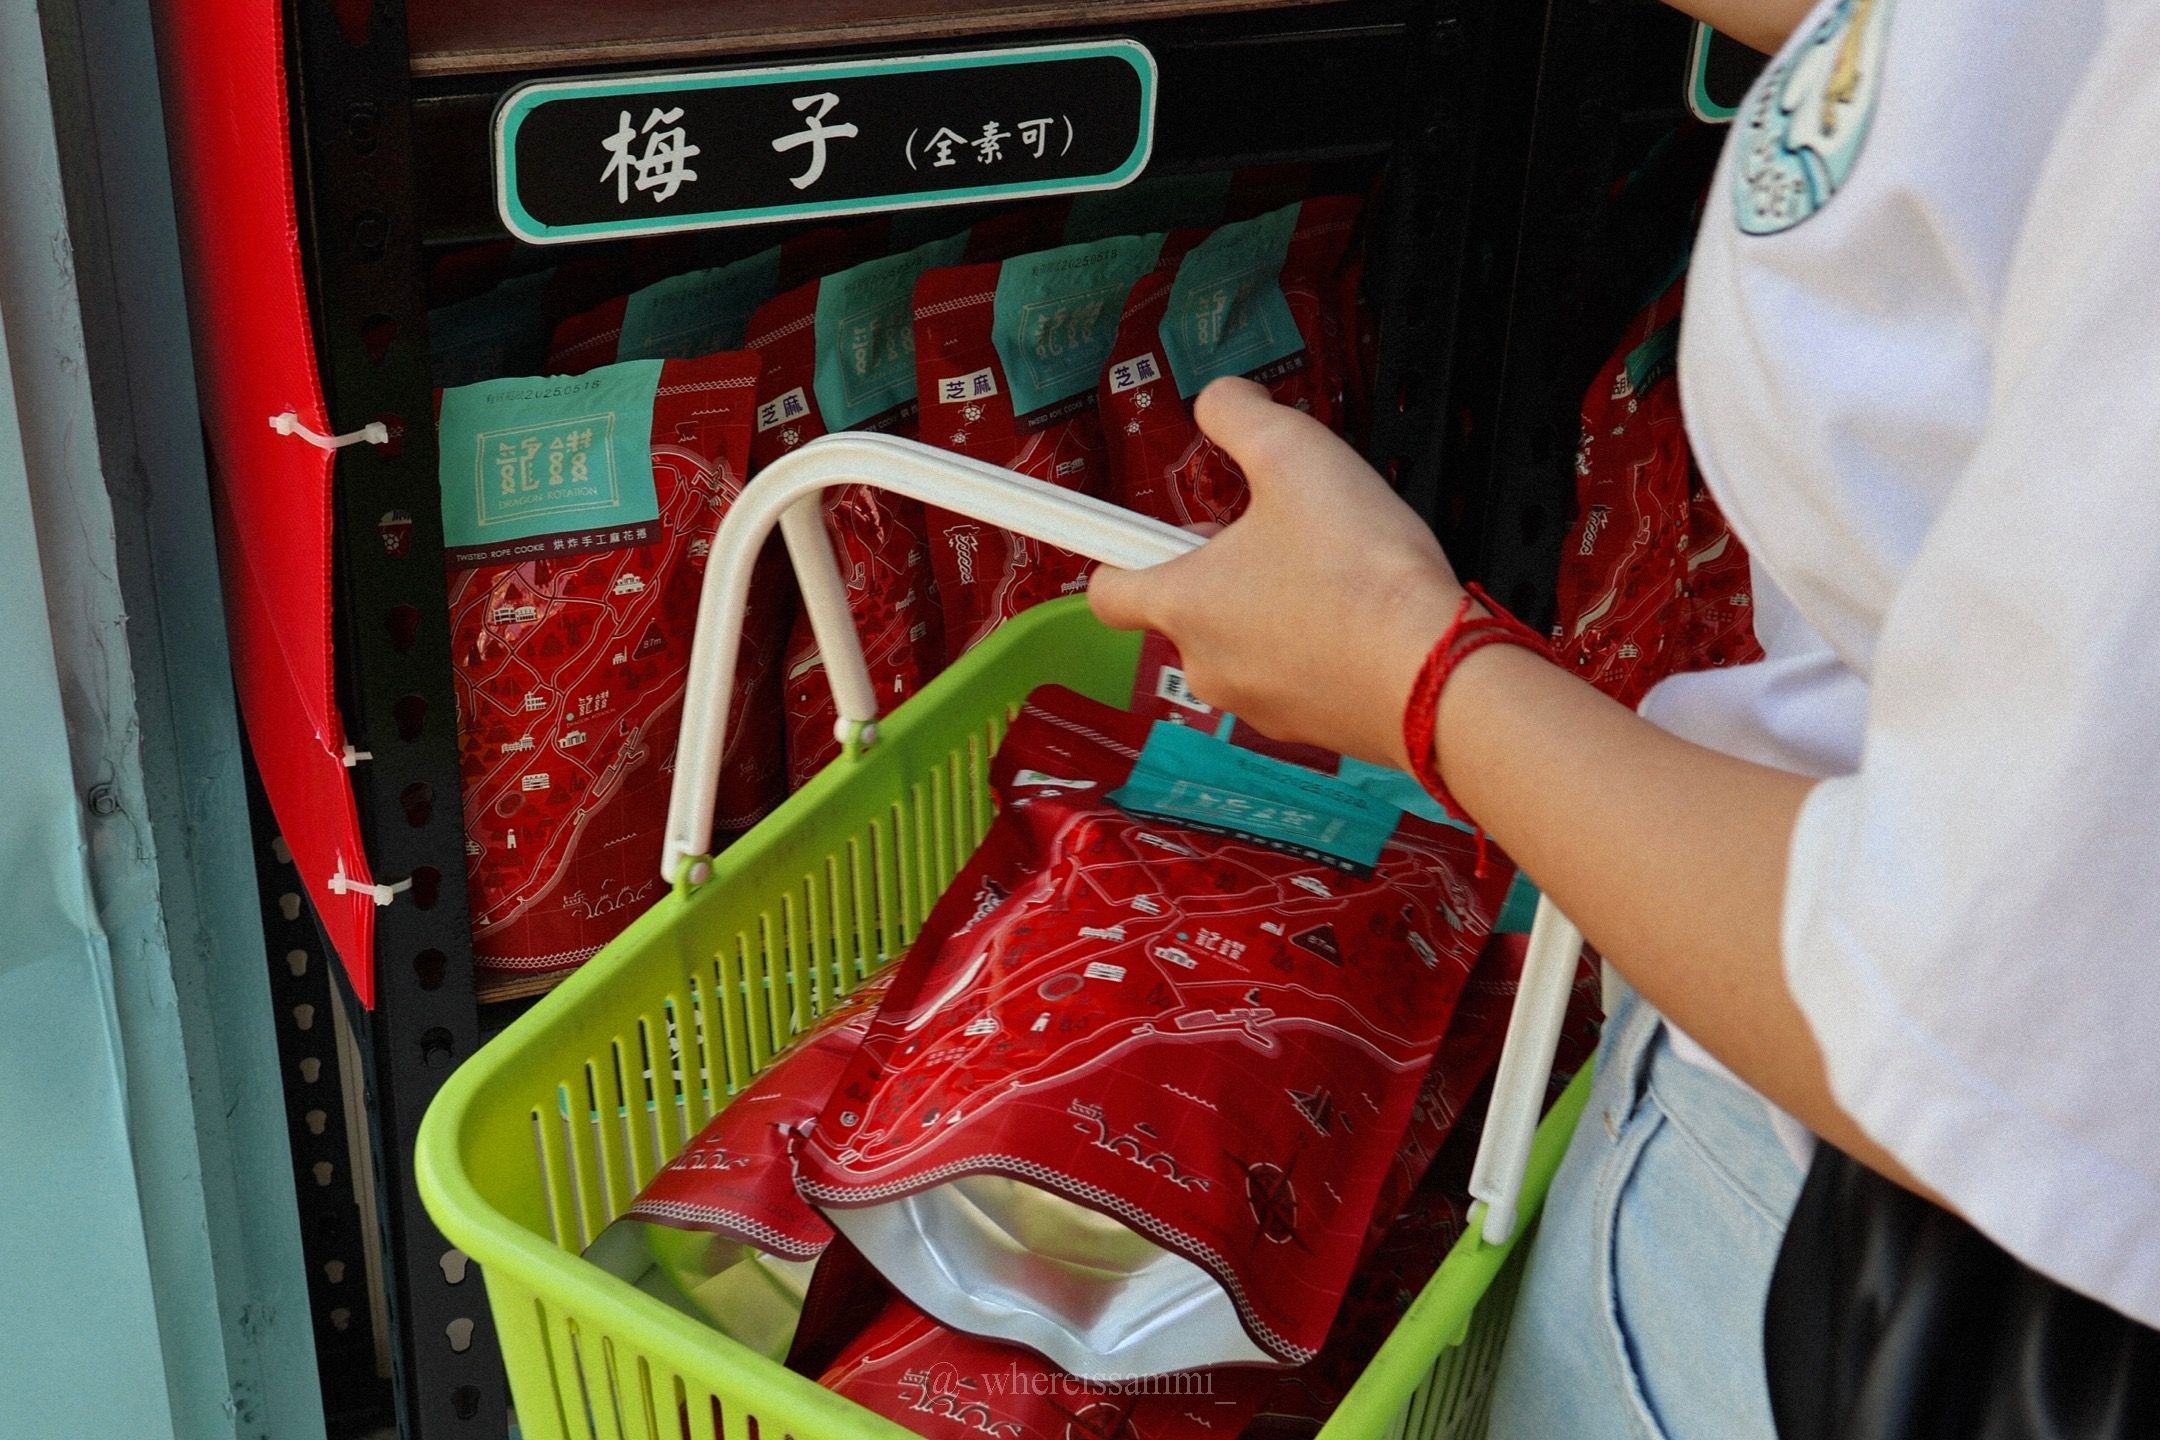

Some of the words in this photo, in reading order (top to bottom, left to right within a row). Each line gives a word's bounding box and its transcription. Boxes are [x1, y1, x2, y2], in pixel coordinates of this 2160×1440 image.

[1113, 358, 1156, 388] 芝麻
[945, 374, 992, 400] 芝麻
[761, 394, 803, 427] 芝麻
[547, 486, 598, 499] ROTATION
[456, 552, 487, 562] TWISTED
[491, 548, 511, 558] ROPE
[514, 543, 545, 554] COOKIE
